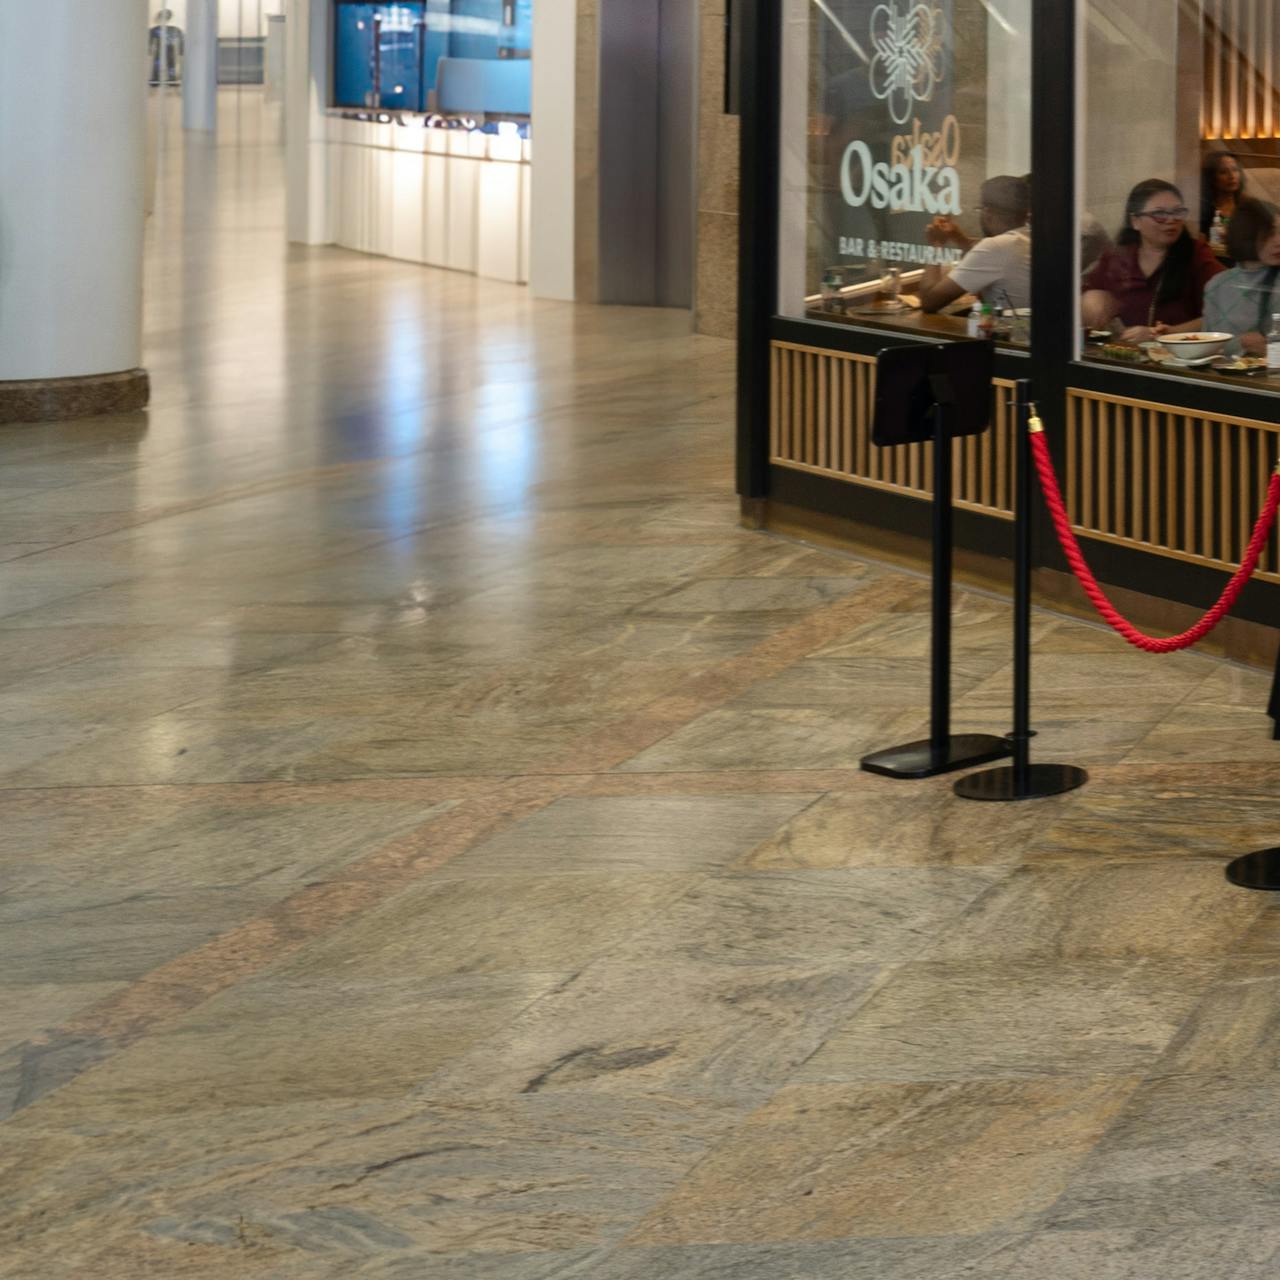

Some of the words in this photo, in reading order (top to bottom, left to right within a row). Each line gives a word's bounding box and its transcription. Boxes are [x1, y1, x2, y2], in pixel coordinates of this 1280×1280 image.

[840, 140, 961, 215] Osaka
[839, 236, 863, 256] BAR
[867, 239, 878, 258] &
[880, 241, 963, 265] RESTAURANT
